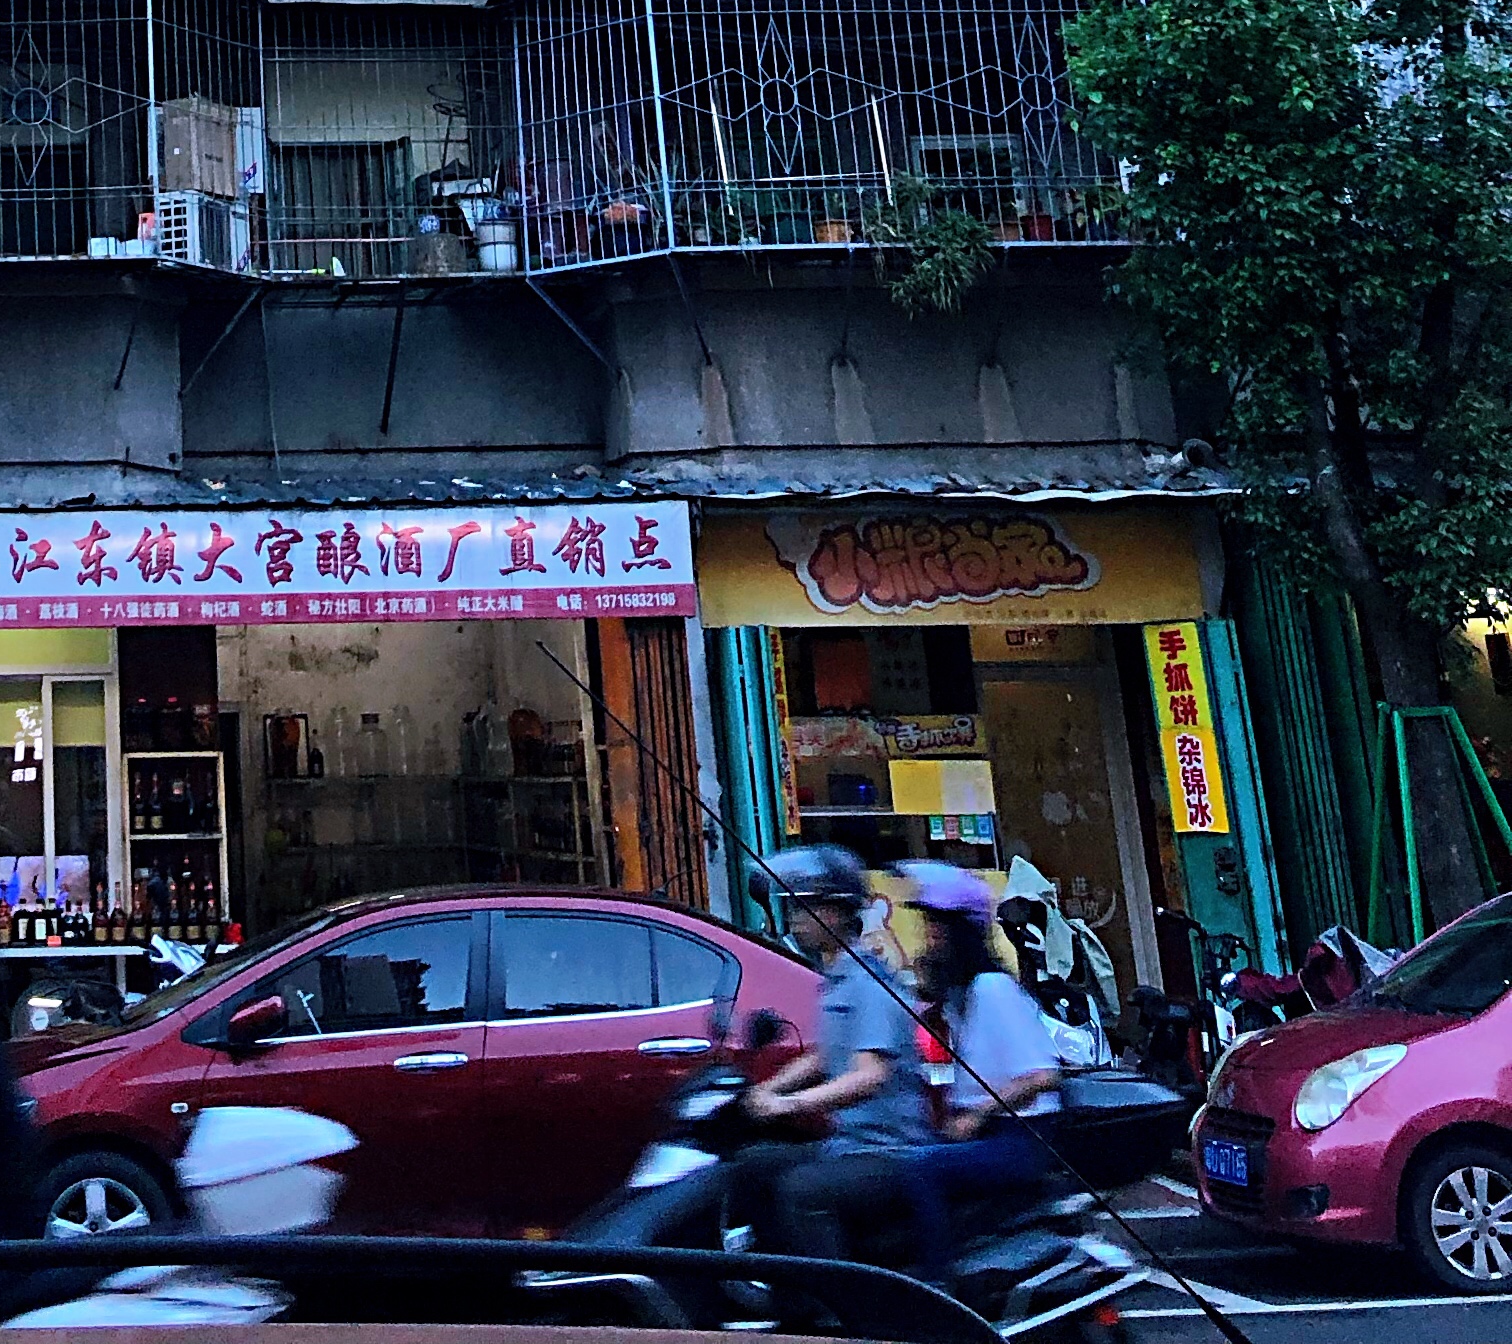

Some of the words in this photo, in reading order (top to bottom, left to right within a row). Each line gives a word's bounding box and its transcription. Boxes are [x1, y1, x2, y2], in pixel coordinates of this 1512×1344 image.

[1159, 628, 1198, 726] 手抓饼
[1177, 735, 1212, 827] 杂锦冰
